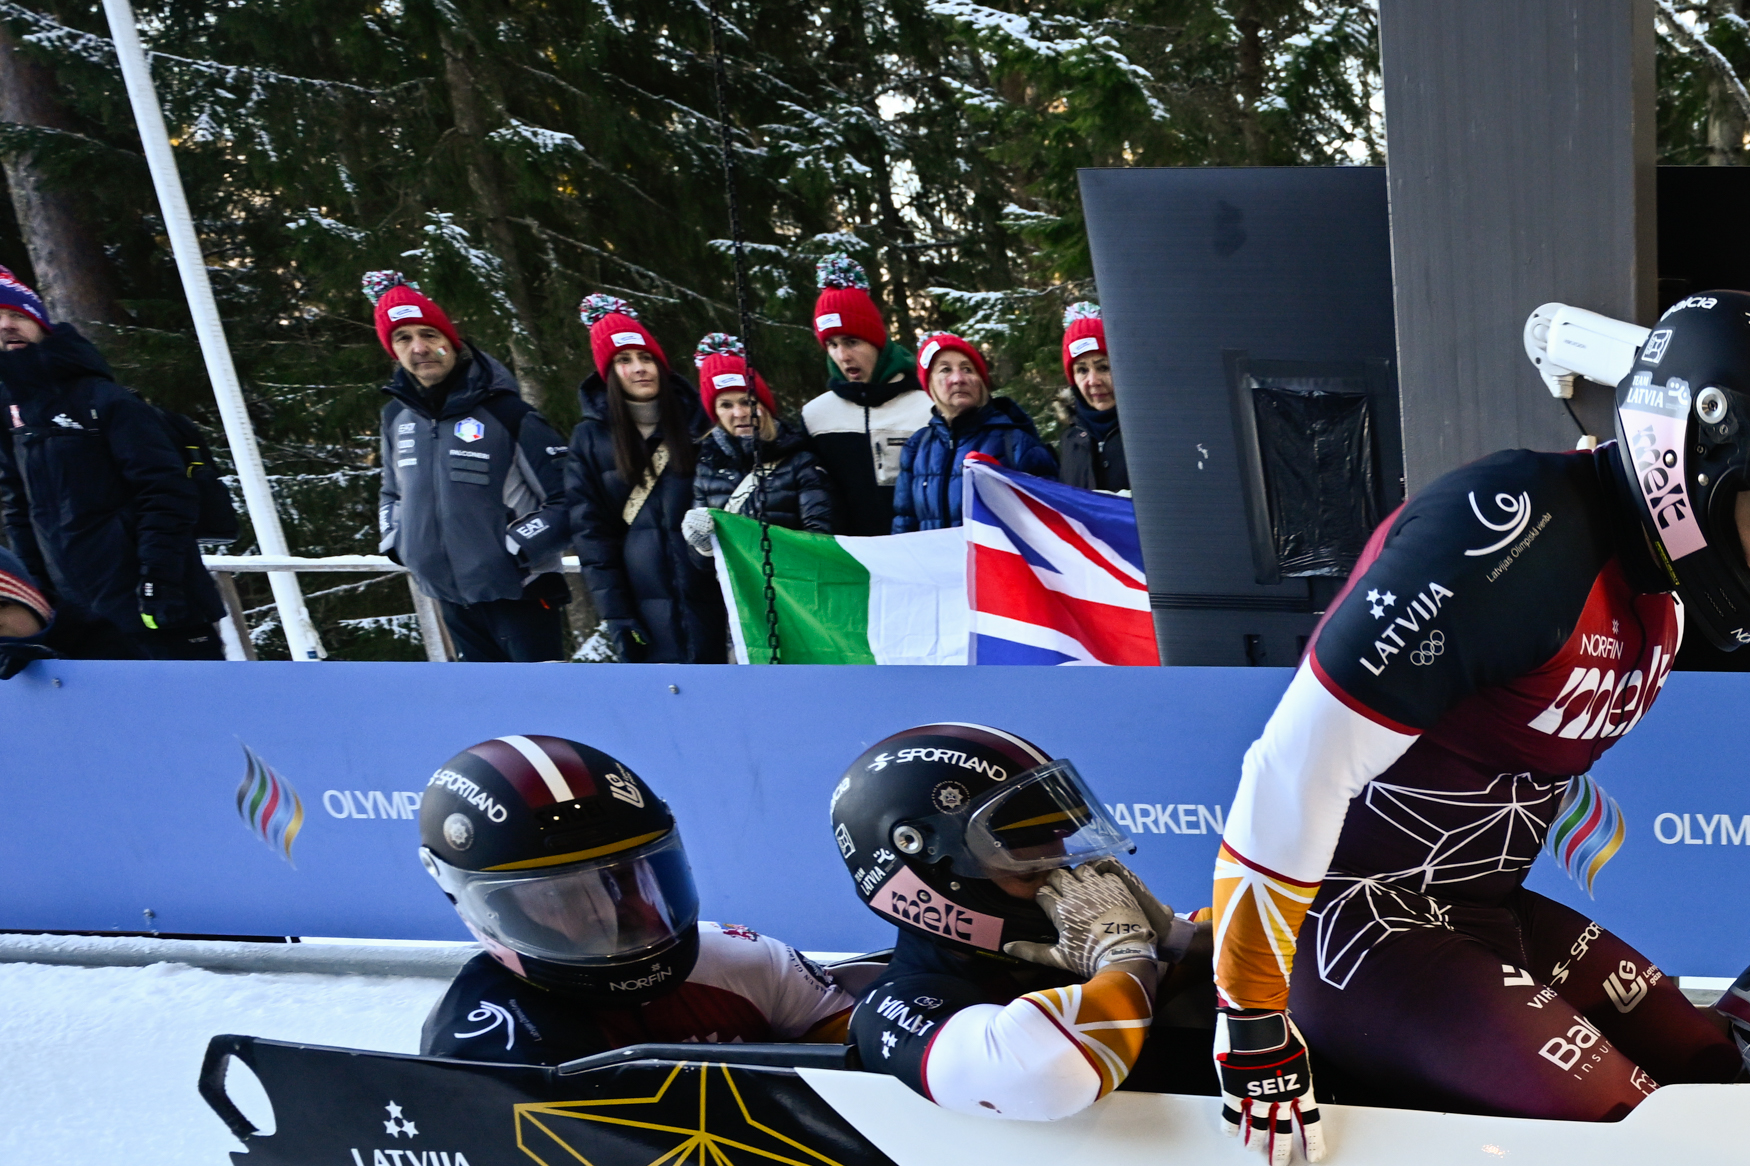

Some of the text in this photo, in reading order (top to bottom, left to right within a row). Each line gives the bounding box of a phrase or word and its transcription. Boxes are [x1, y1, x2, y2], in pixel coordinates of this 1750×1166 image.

[1632, 374, 1650, 387] TEAM
[1626, 387, 1664, 408] LATVIA
[1632, 425, 1687, 530] melt
[516, 518, 545, 538] EA7
[1486, 555, 1513, 583] Latvijas
[1359, 581, 1454, 677] LATVIJA
[1580, 633, 1624, 660] NORFIN
[896, 748, 1008, 782] SPORTLAND
[323, 789, 425, 820] OLYMP
[437, 769, 508, 823] SPORTLAND
[860, 866, 887, 896] LATVIA
[891, 891, 973, 942] melt
[609, 966, 672, 991] NORFIN
[1246, 1069, 1300, 1097] SEIZ
